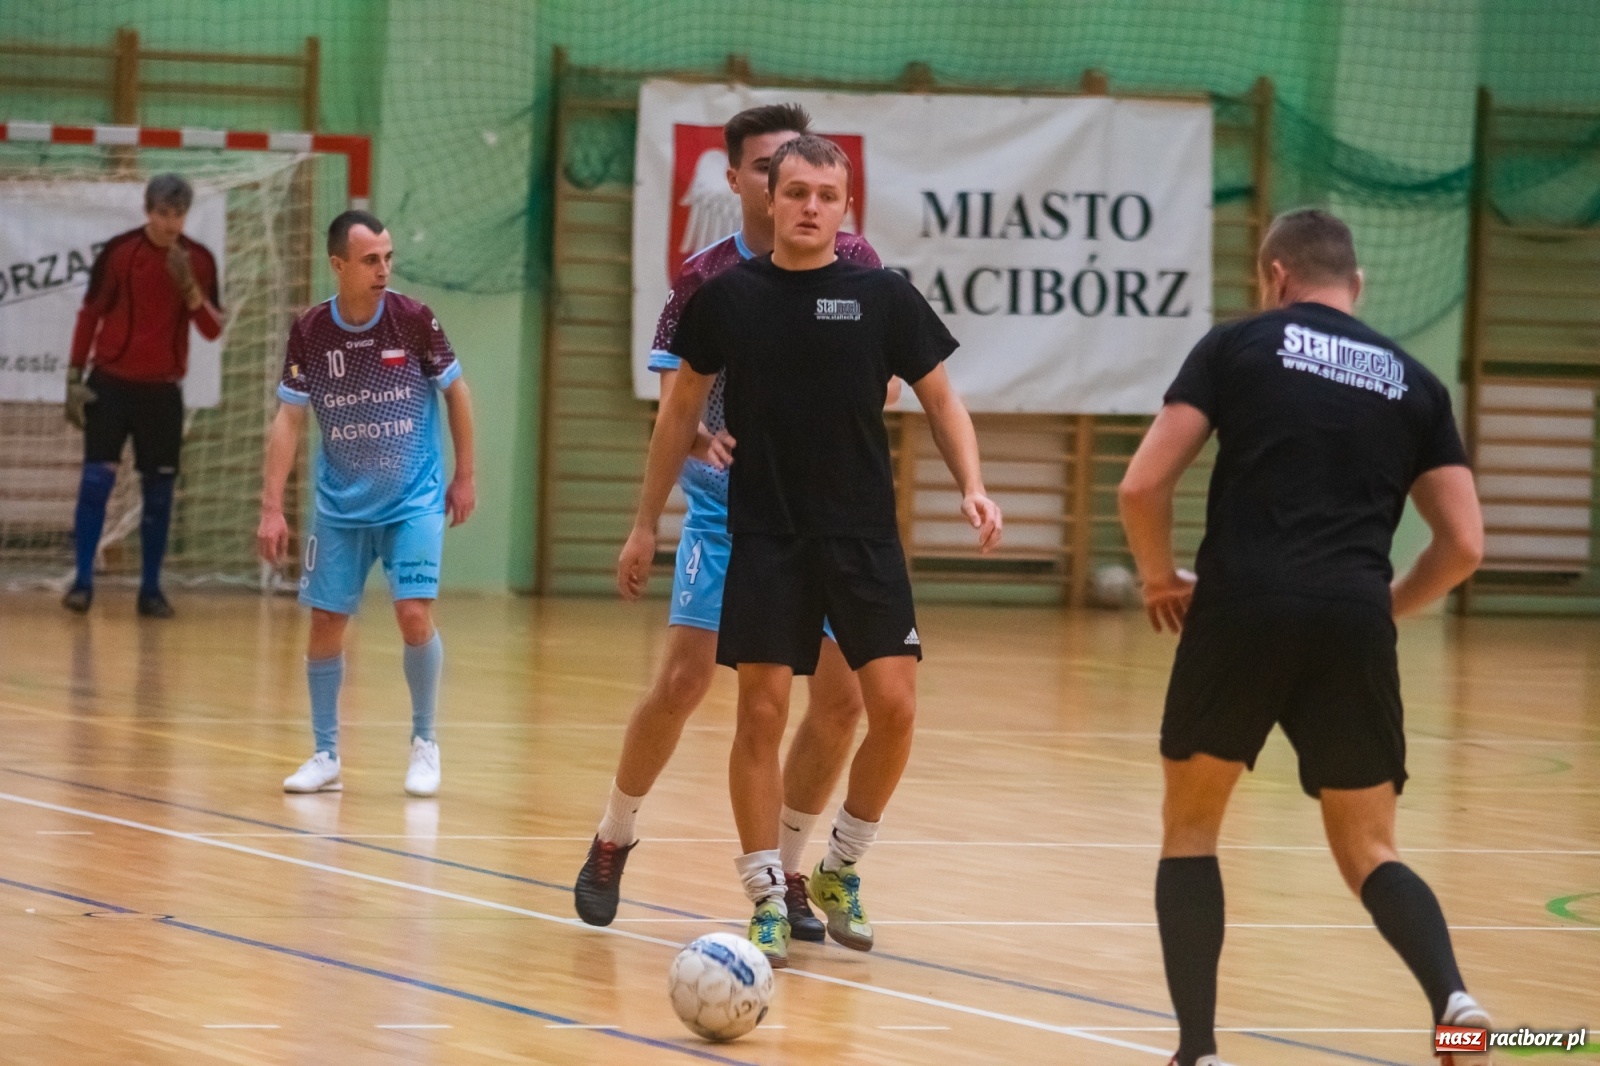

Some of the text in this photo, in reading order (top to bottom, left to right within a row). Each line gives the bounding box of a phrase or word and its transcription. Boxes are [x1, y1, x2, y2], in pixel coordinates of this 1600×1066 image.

[921, 190, 1152, 242] MIASTO
[326, 349, 345, 379] 10
[1283, 323, 1404, 383] Staltech
[323, 385, 412, 408] Geo-Punkt
[1282, 356, 1404, 400] www.staltech.pl
[331, 418, 413, 441] AGROTIM
[685, 539, 703, 585] 4
